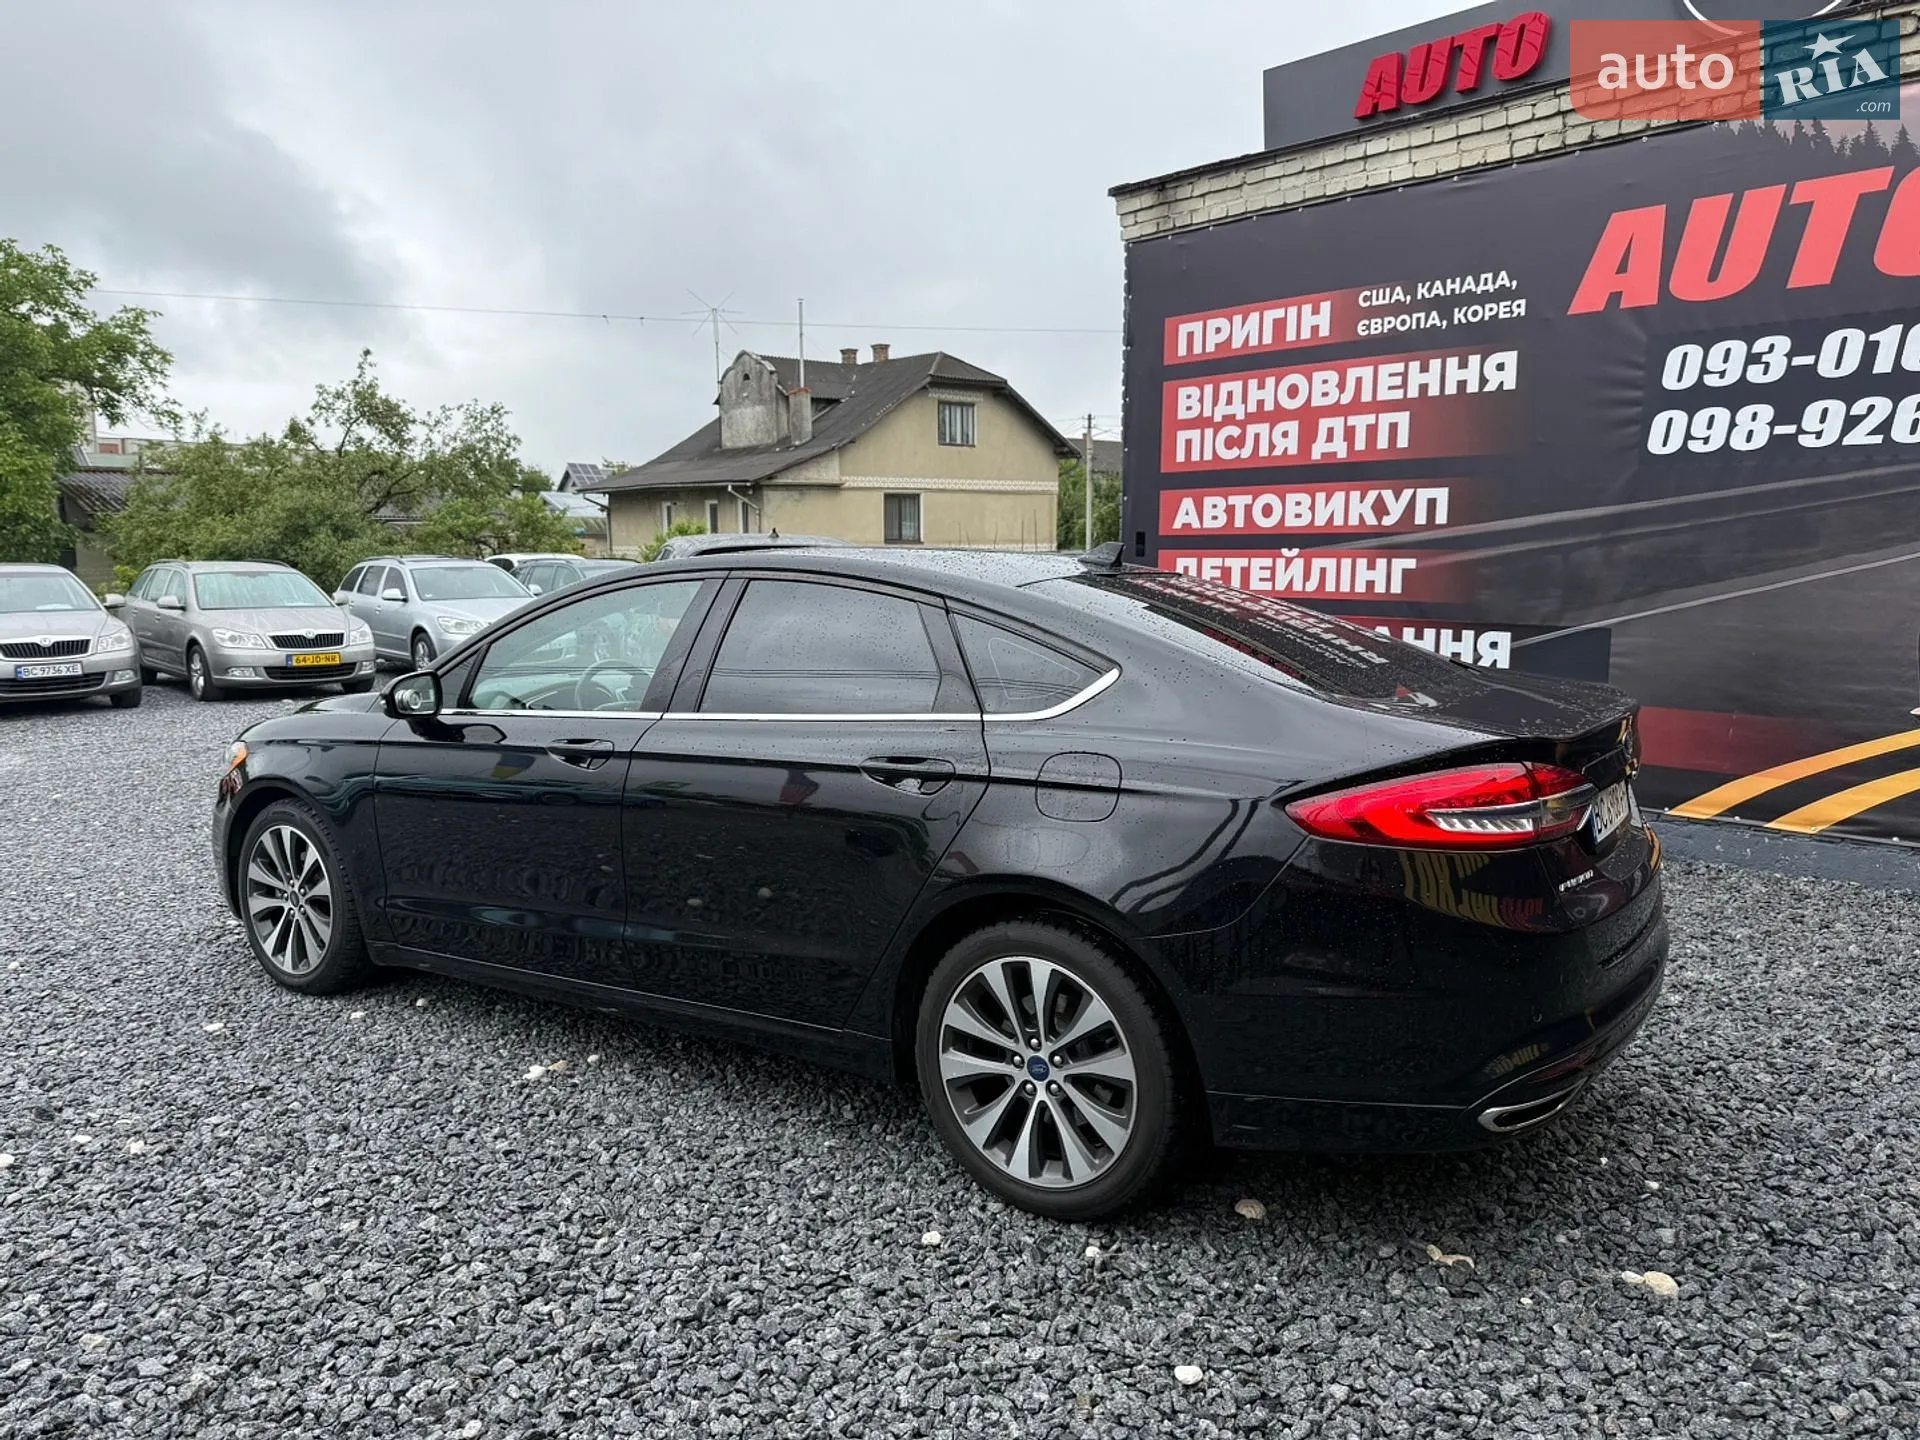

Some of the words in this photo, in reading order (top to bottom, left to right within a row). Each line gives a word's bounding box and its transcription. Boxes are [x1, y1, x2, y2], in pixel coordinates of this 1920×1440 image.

[1354, 11, 1552, 120] AUTO
[1358, 286, 1412, 308] США,
[1416, 270, 1518, 300] КАНАДА,
[1177, 301, 1331, 357] ПРИГІН
[1357, 311, 1447, 336] ЄВРОПА,
[1453, 298, 1527, 325] КОРЕЯ
[1176, 351, 1518, 421] ВІДНОВЛЕННЯ
[1175, 421, 1299, 462] ПІСЛЯ
[1311, 410, 1411, 460] ДТП
[1172, 487, 1449, 529] АВТОВИКУП
